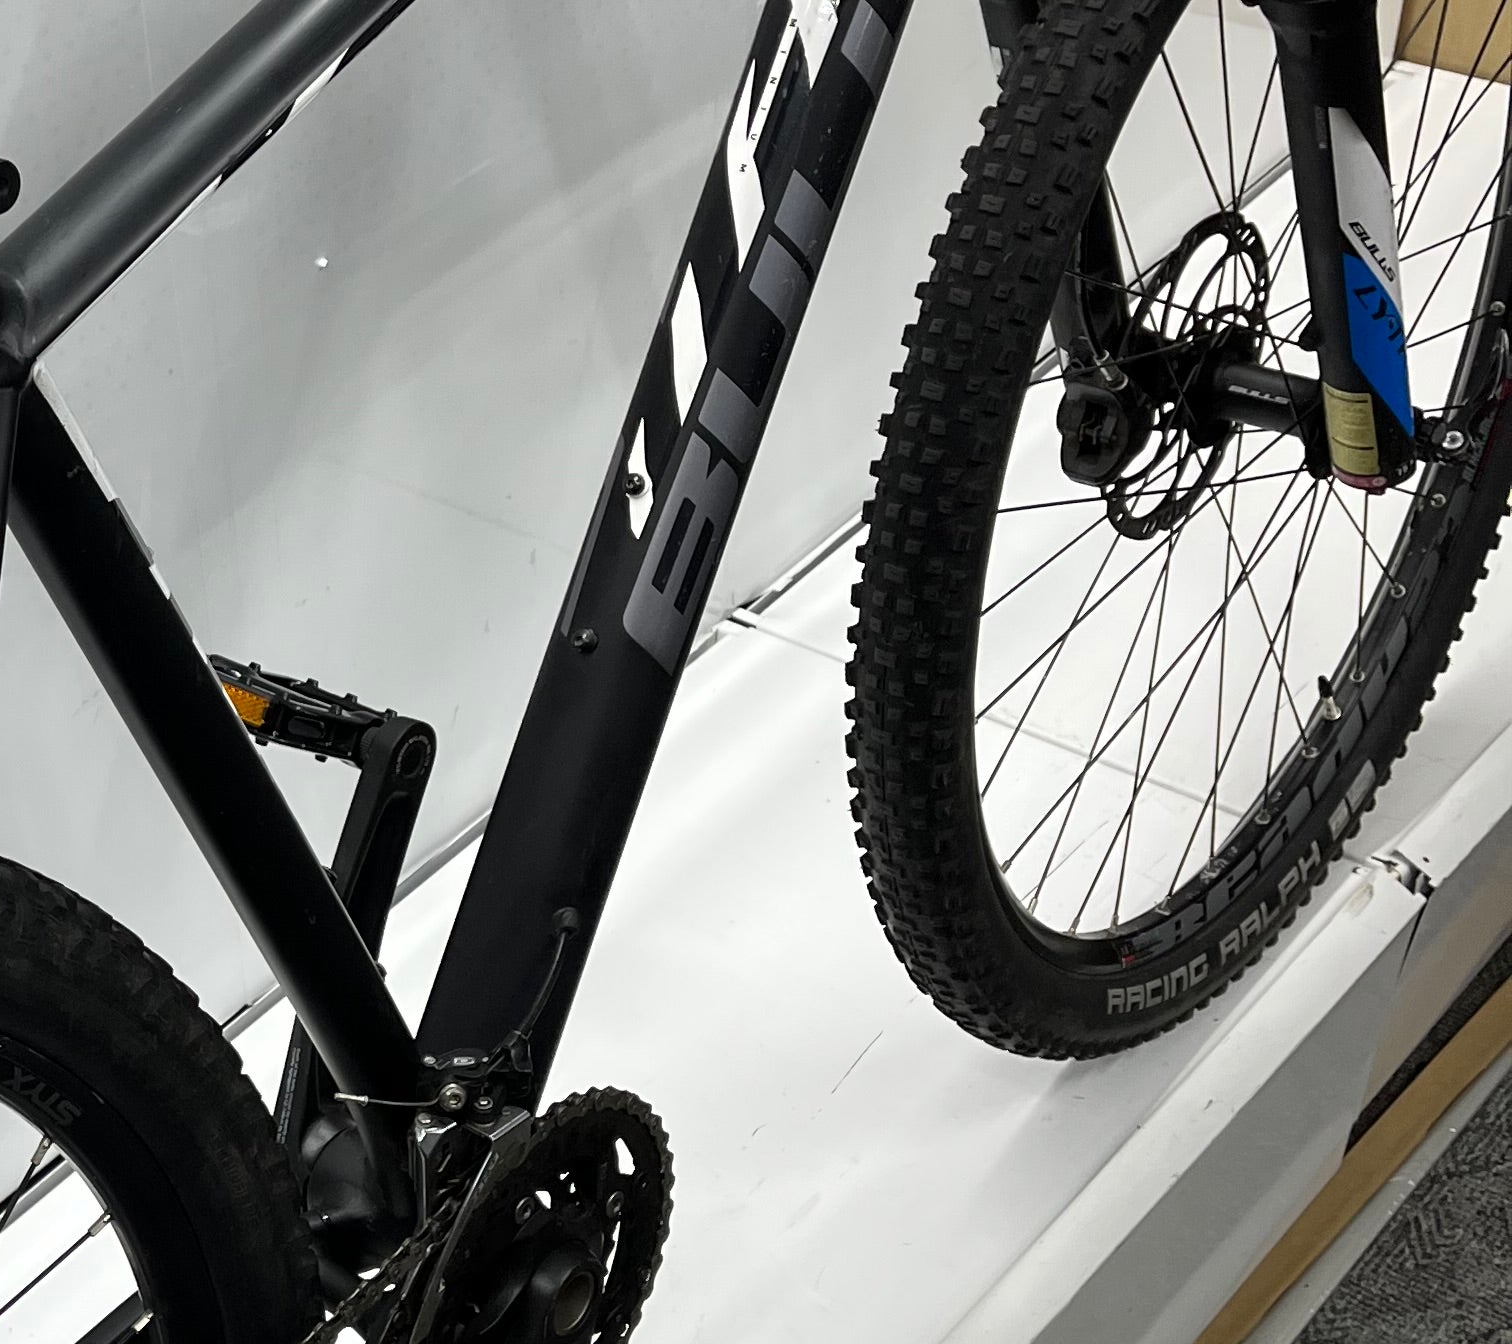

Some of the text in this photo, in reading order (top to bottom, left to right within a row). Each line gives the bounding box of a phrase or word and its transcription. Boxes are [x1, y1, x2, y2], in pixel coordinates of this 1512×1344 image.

[1348, 220, 1396, 283] BULLS
[1107, 840, 1321, 1015] RACING RALPH
[3, 1065, 83, 1128] STYX
